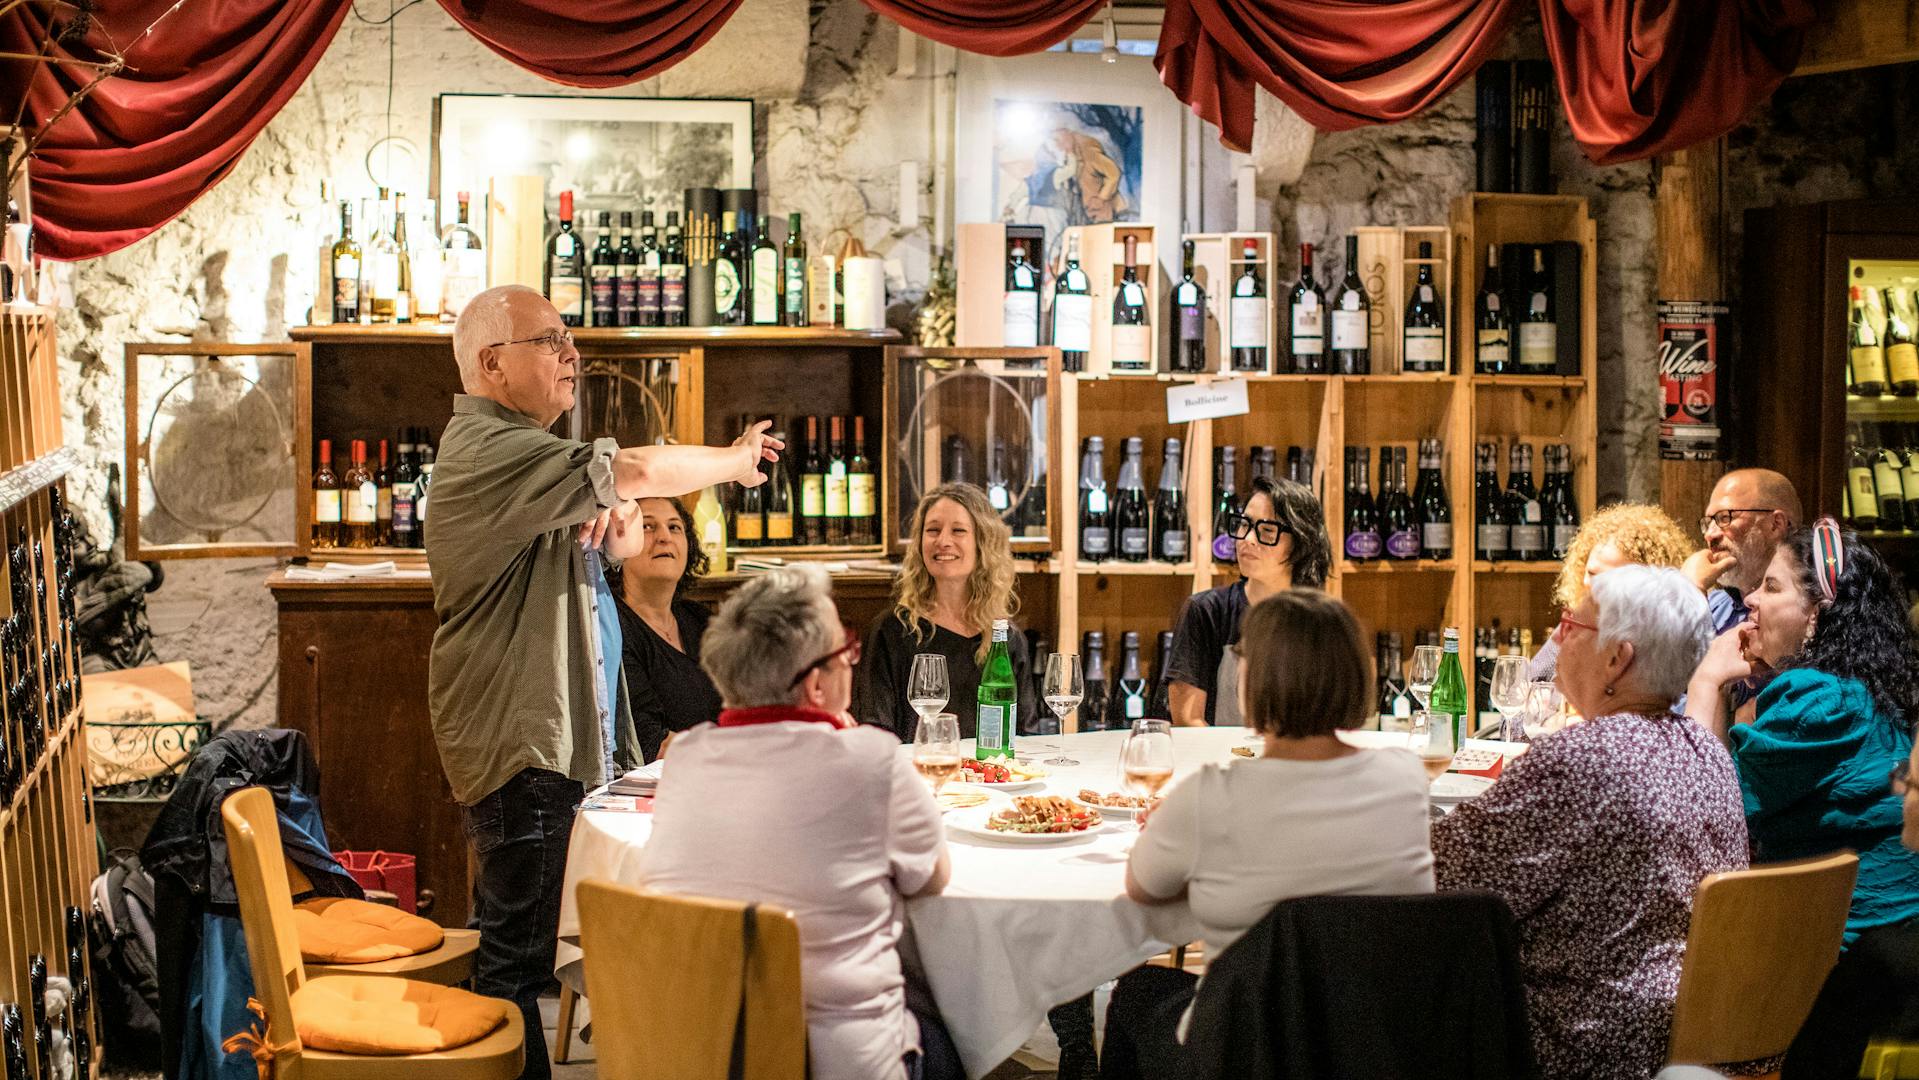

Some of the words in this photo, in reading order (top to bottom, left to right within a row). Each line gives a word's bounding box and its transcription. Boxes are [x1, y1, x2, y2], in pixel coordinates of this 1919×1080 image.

[1657, 338, 1717, 375] Wine
[1665, 374, 1703, 382] TASTING
[1185, 395, 1229, 407] Bollicine
